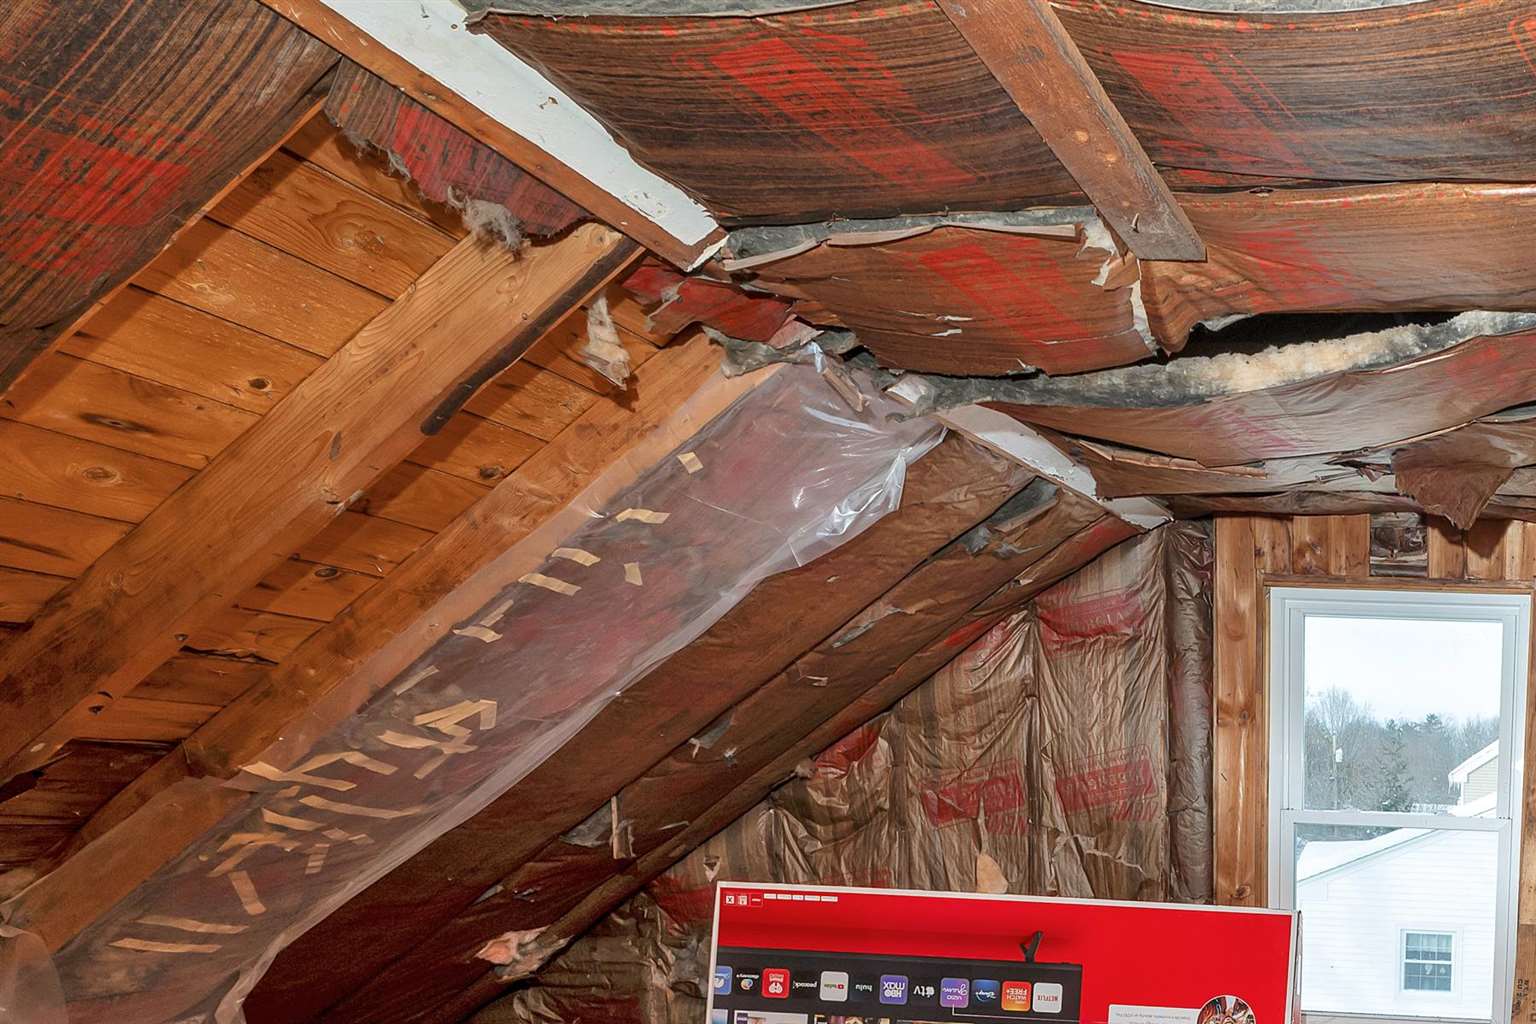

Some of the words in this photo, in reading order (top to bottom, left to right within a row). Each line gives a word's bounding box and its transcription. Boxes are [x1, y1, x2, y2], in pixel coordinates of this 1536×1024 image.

[855, 984, 873, 993] hulu
[883, 981, 906, 991] max
[884, 989, 902, 998] HBO
[1036, 994, 1059, 1002] NETFLIX
